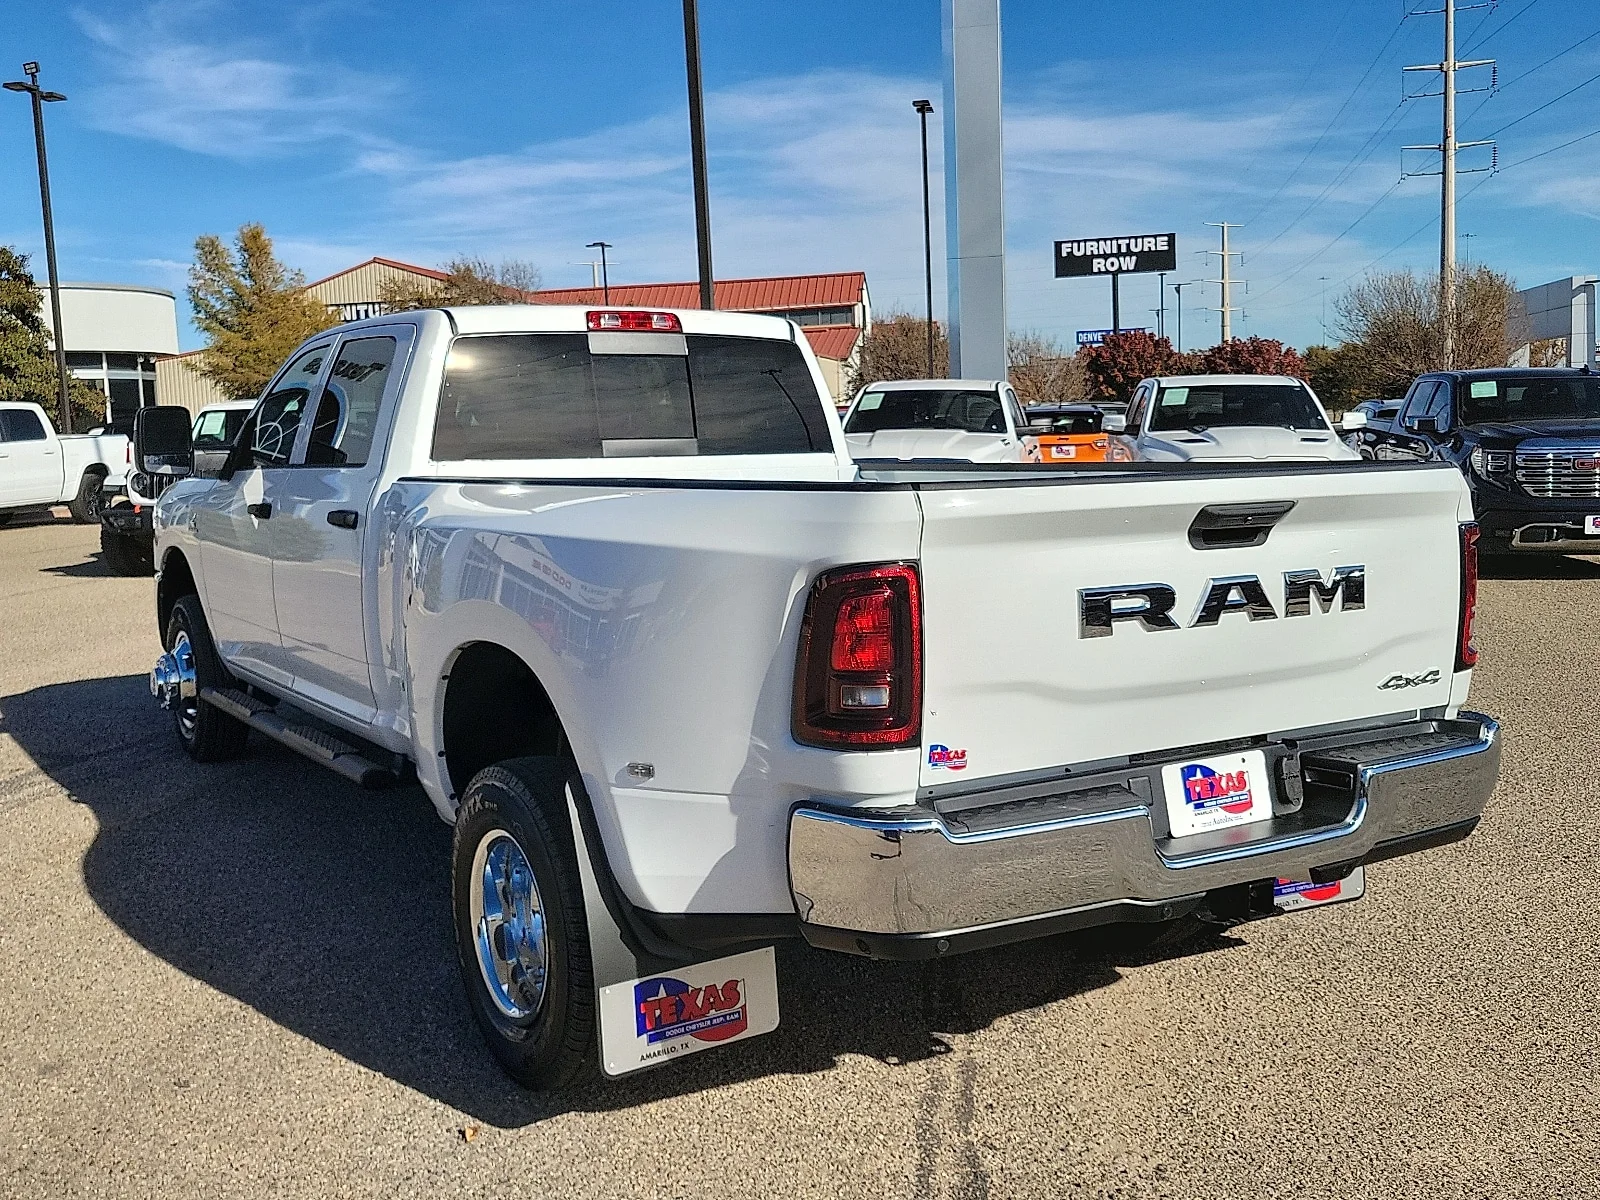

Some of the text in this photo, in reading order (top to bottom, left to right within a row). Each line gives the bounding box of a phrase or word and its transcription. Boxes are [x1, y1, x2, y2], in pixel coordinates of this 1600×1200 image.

[1061, 236, 1169, 257] FURNITURE
[1092, 255, 1137, 273] ROW
[1078, 331, 1107, 343] DENVE
[1075, 565, 1367, 640] RAM
[930, 749, 967, 762] TEXAS
[1186, 770, 1247, 800] TEXAS
[641, 980, 740, 1030] TEXAS
[665, 1027, 685, 1037] DODGE
[685, 1020, 711, 1034] CHRYSLER
[680, 1041, 690, 1050] TX
